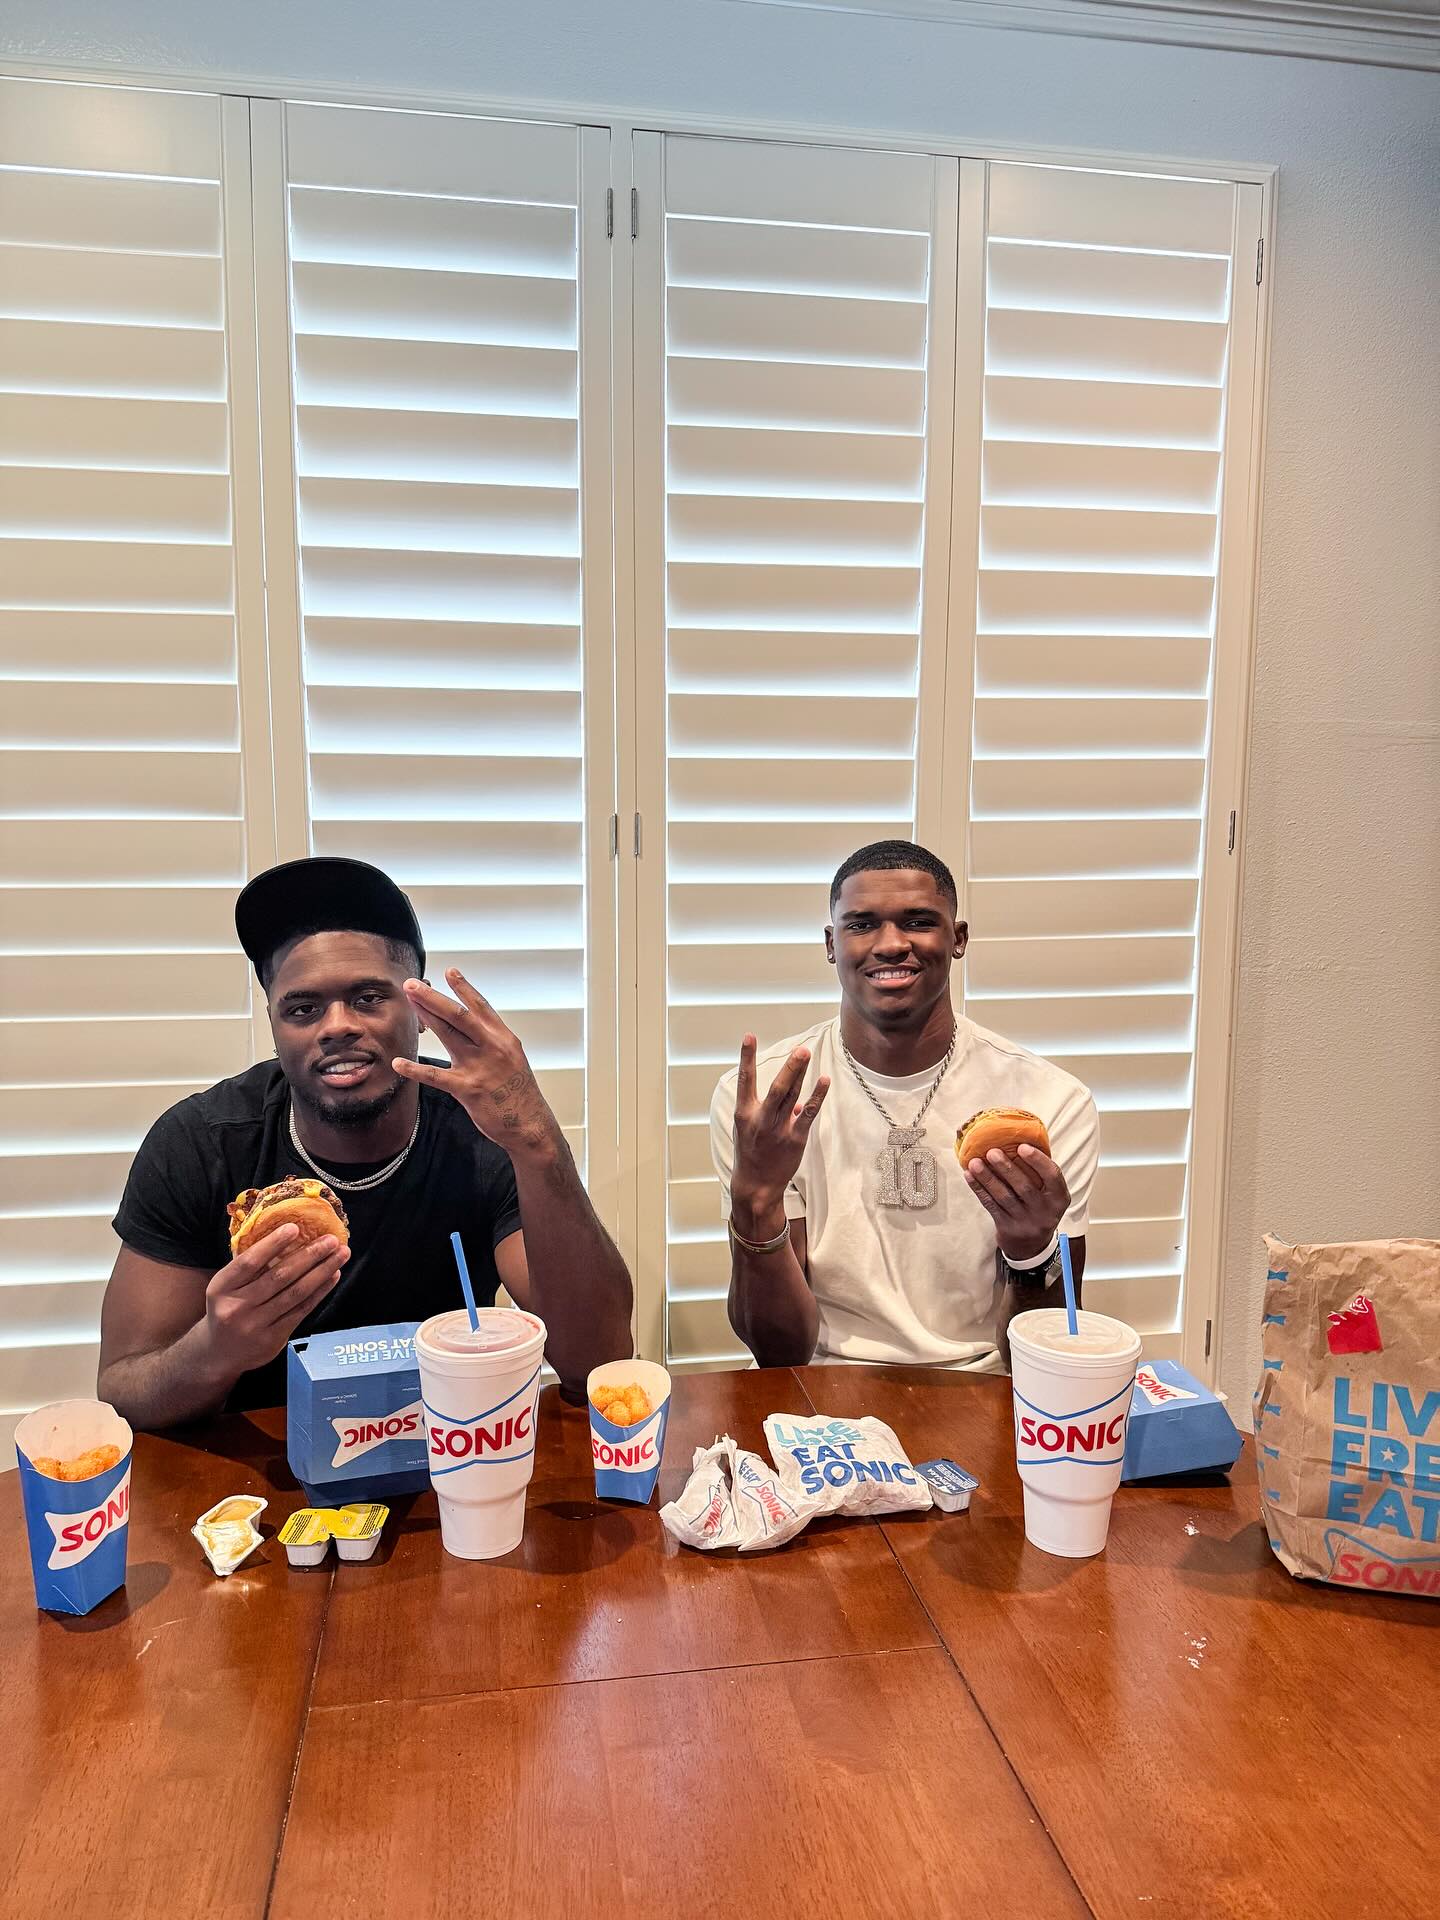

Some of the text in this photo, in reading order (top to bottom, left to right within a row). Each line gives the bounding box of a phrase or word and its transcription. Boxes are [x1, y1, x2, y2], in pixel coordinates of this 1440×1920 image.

[876, 1146, 937, 1209] 10
[338, 1351, 379, 1366] FREE
[1136, 1372, 1178, 1400] SONIC
[344, 1412, 420, 1448] SONIC
[430, 1405, 532, 1458] SONIC
[1020, 1413, 1125, 1453] SONIC
[592, 1436, 654, 1467] SONIC
[791, 1443, 856, 1468] EAT
[800, 1460, 917, 1496] SONIC
[59, 1484, 129, 1552] SONI
[755, 1486, 787, 1525] SONIC
[1326, 1479, 1440, 1543] EAT
